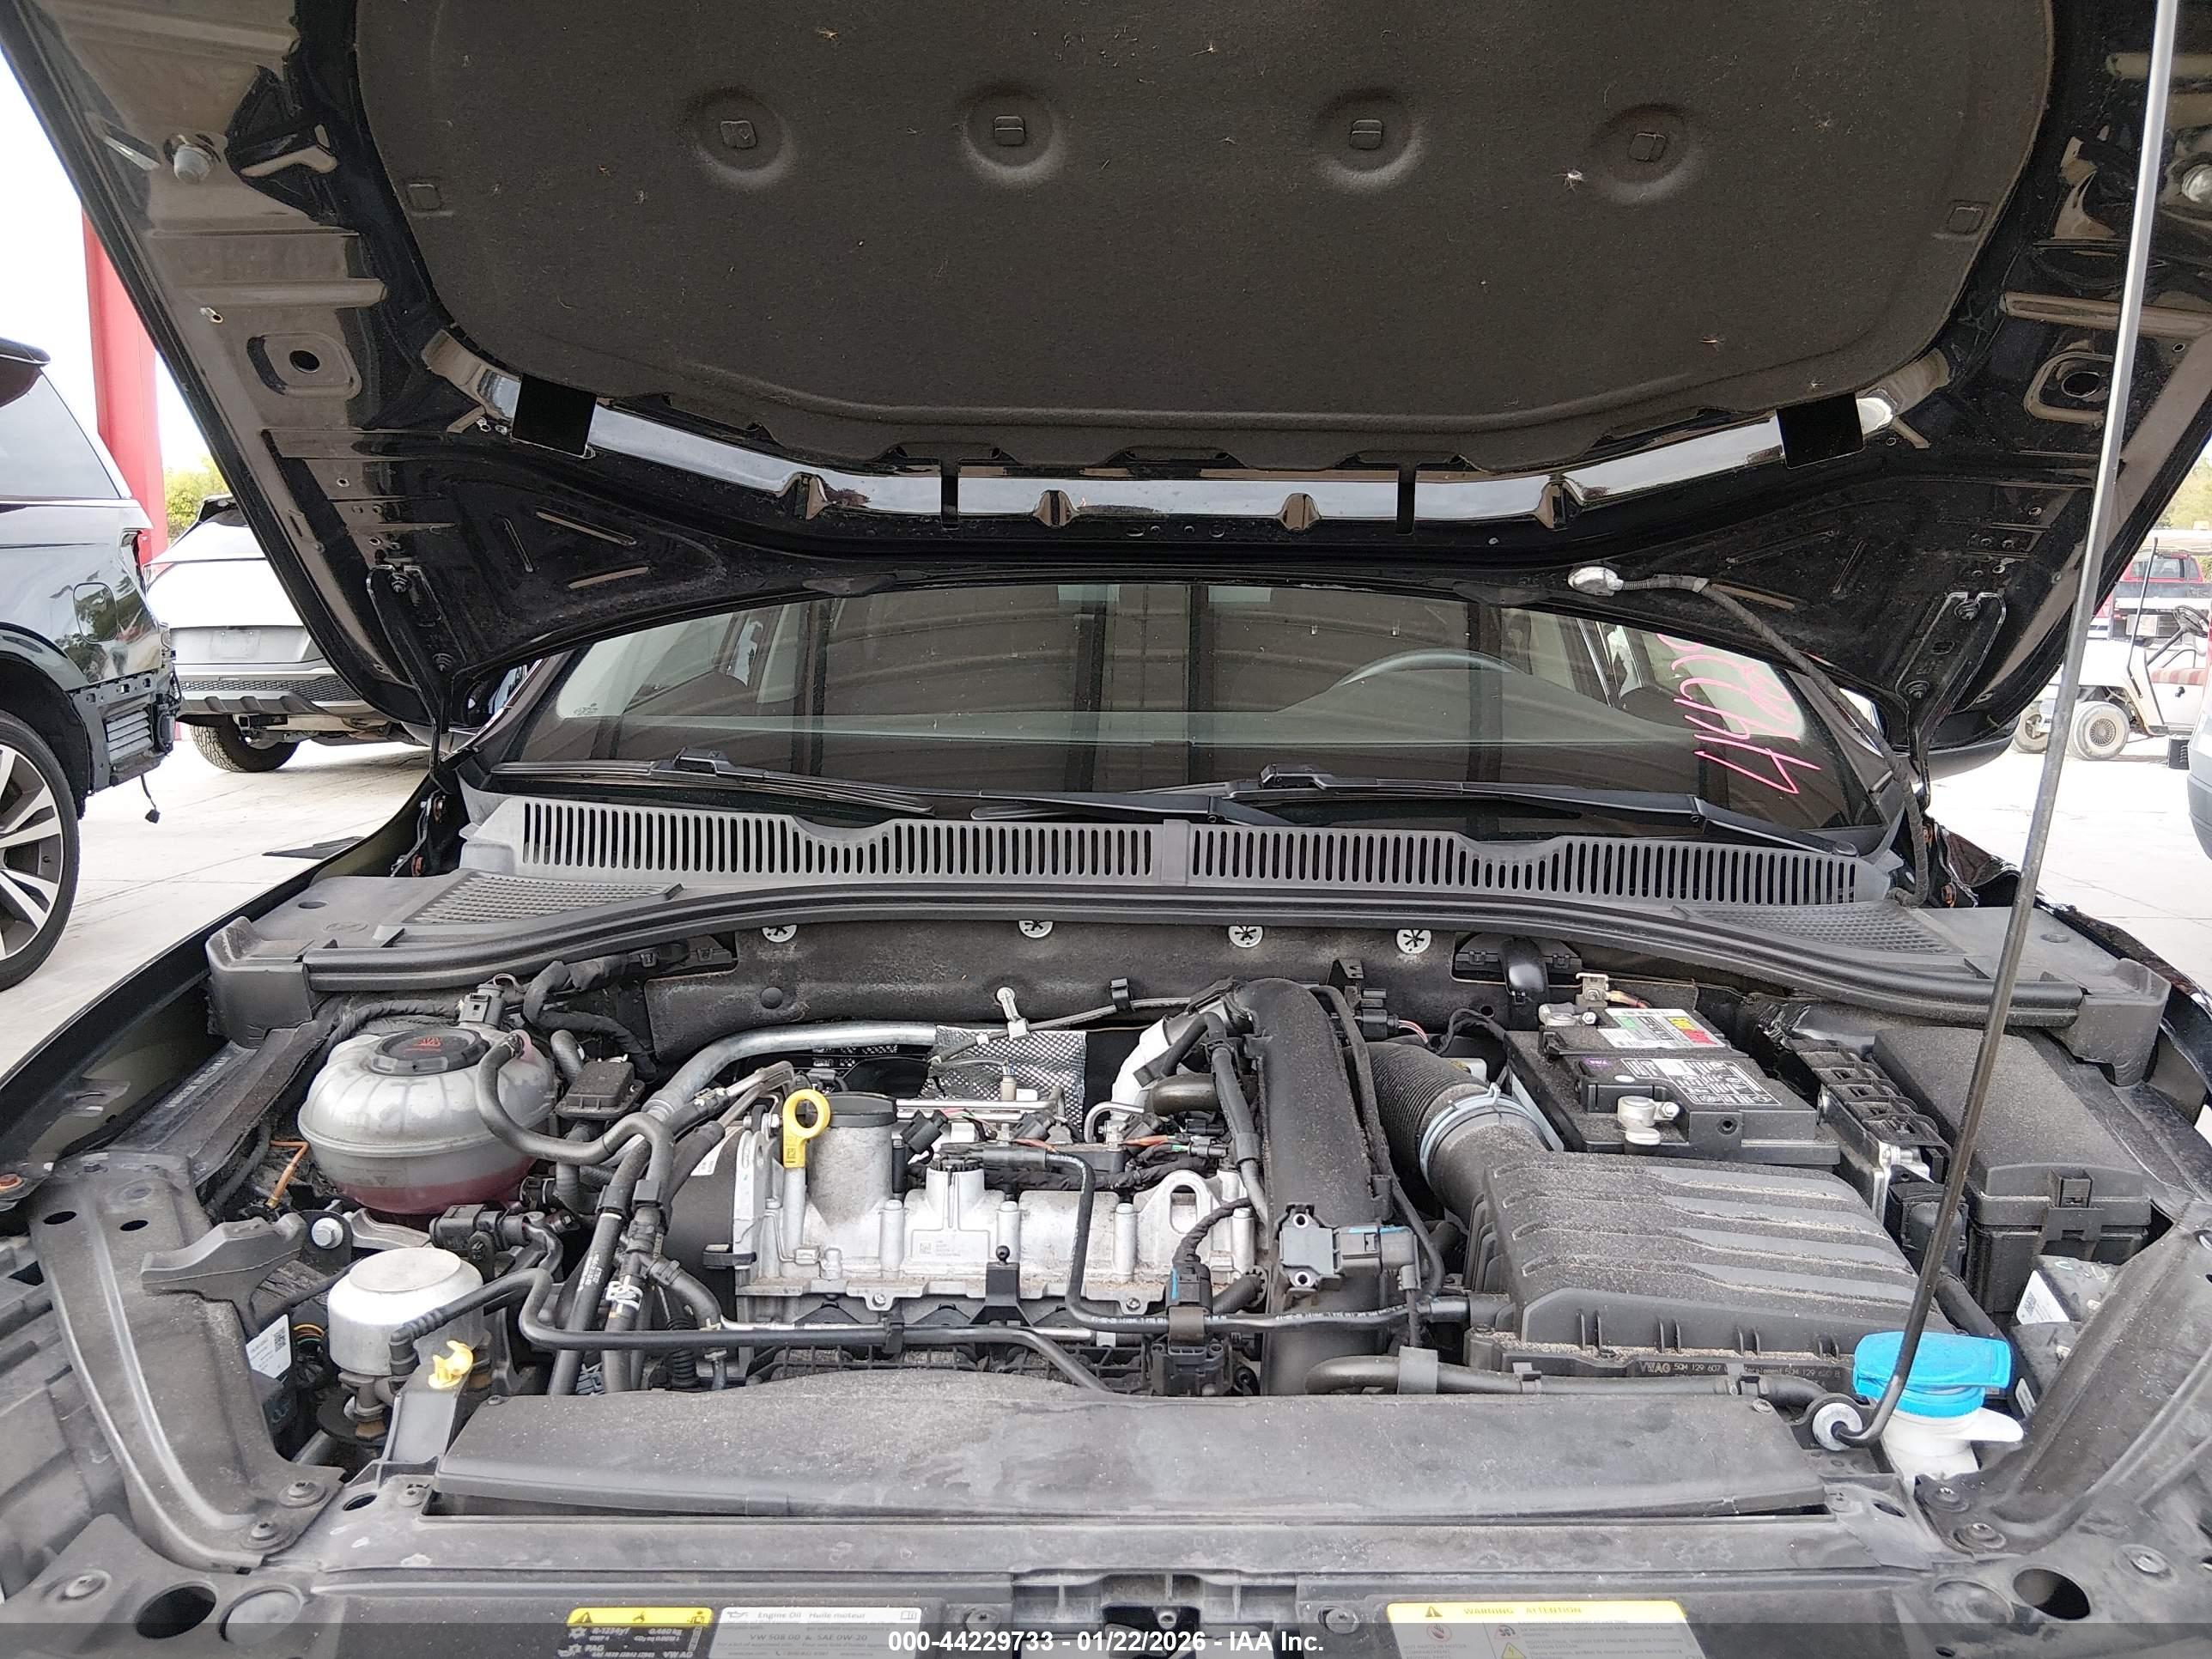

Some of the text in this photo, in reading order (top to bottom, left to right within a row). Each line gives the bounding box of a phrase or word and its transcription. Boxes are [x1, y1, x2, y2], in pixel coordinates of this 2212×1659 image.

[757, 1612, 786, 1620] Engine
[817, 1633, 835, 1642] SAE
[584, 1644, 605, 1652] PAG
[663, 1650, 694, 1659] VW AG
